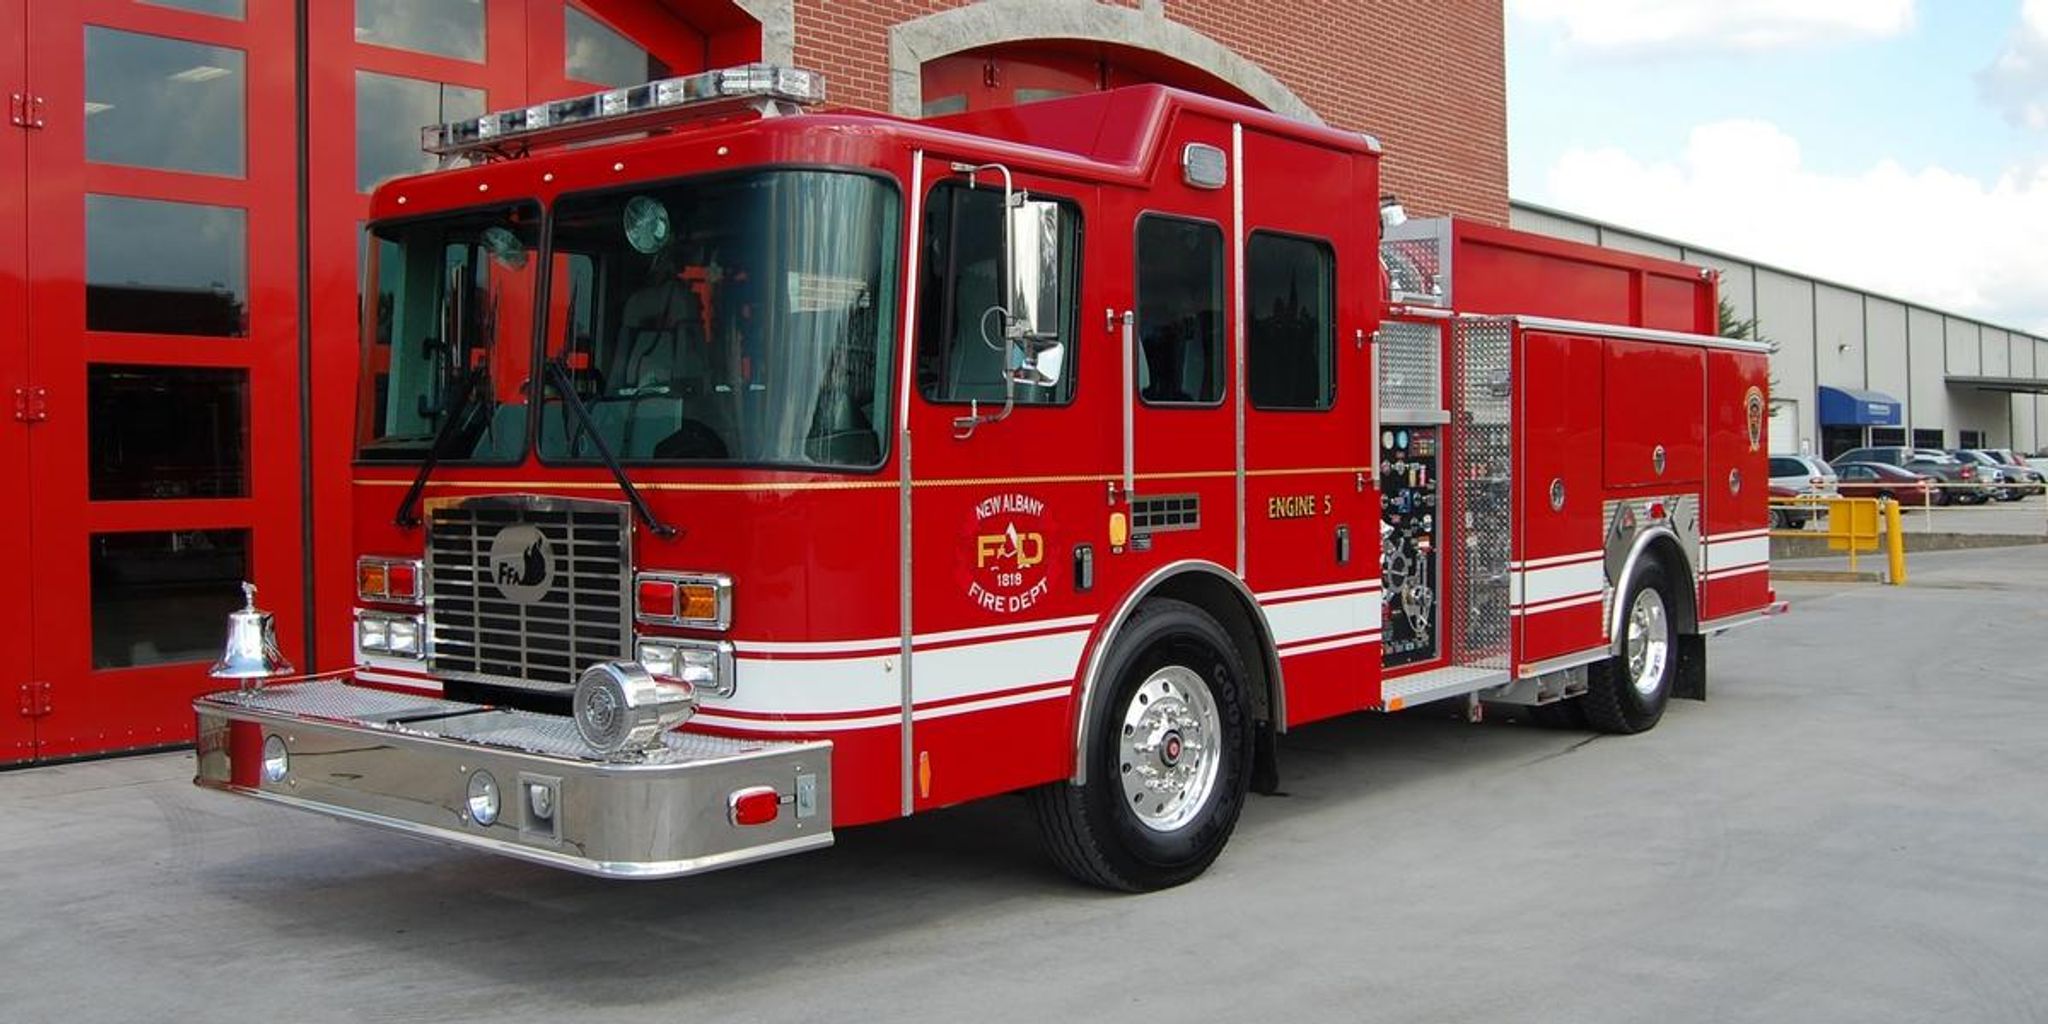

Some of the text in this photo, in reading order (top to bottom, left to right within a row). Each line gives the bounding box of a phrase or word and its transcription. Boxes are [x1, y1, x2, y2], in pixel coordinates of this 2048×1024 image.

[975, 493, 1045, 520] NEW ALBANY
[1268, 494, 1332, 519] ENGINE 5
[997, 573, 1023, 588] 1818
[968, 576, 1049, 613] FIRE DEPT
